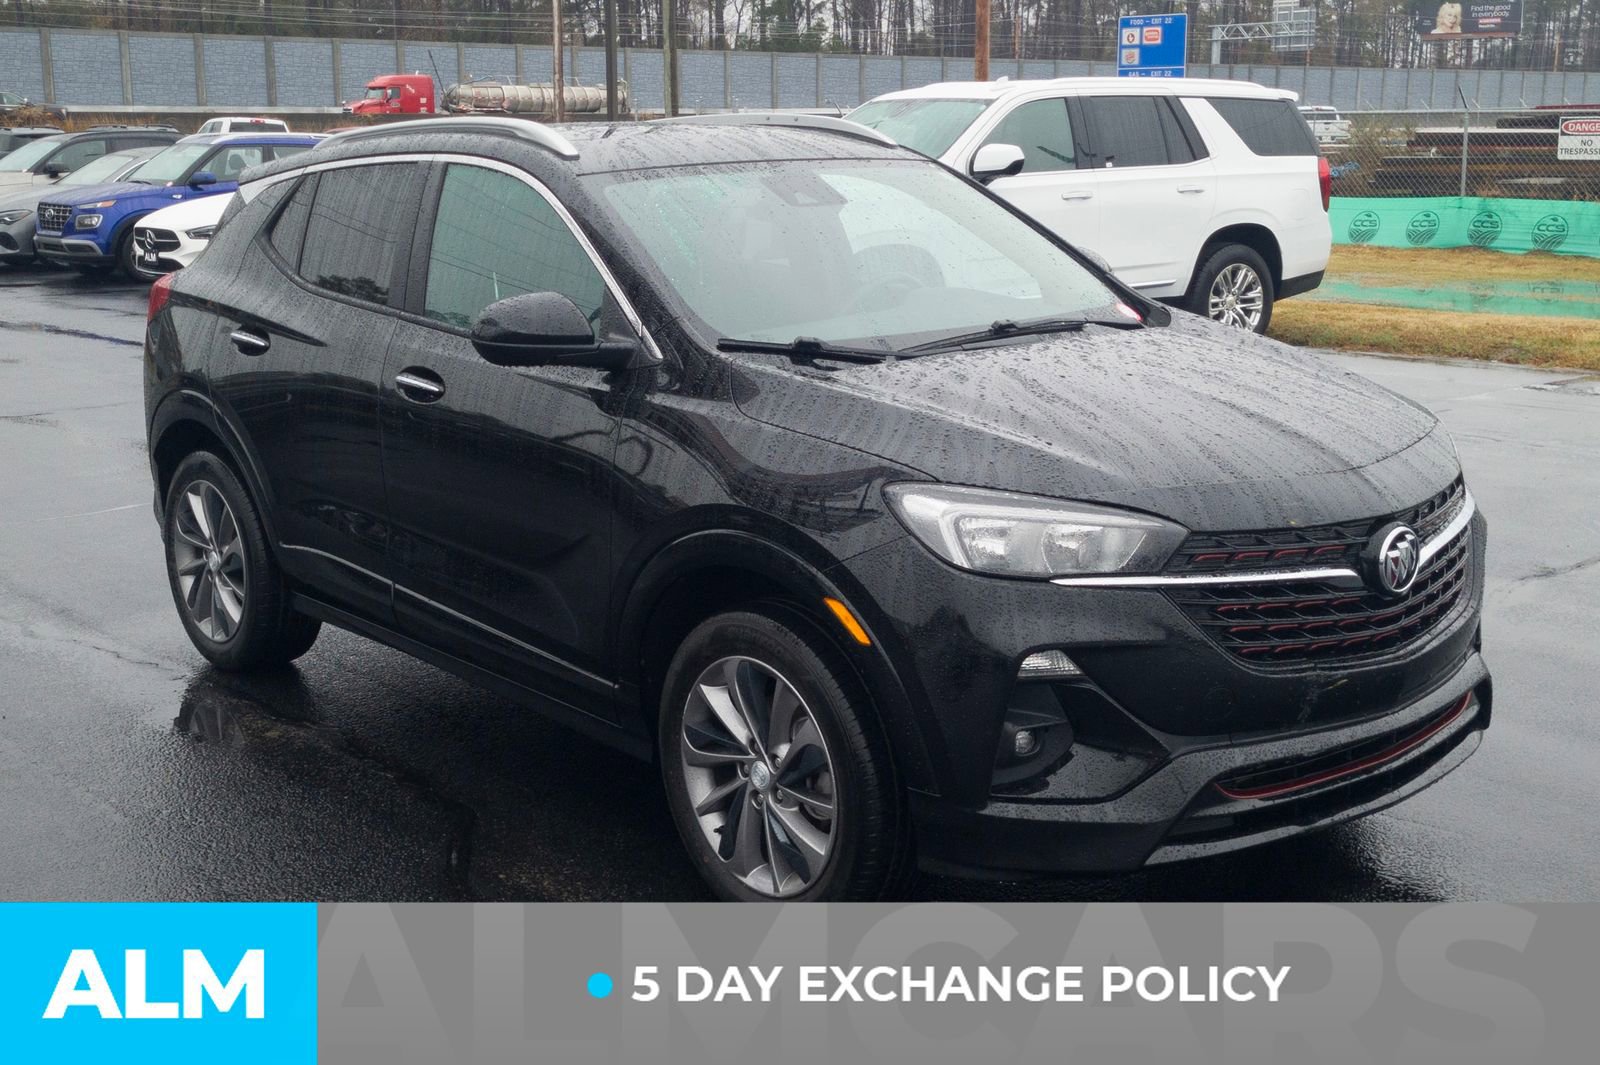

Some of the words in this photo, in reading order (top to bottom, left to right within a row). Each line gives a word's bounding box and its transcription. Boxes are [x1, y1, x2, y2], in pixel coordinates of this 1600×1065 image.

[1580, 139, 1593, 147] NO
[1353, 219, 1377, 227] CCS
[1411, 219, 1436, 228] CCS
[1472, 219, 1500, 229] CCS
[1536, 223, 1566, 232] CCS
[145, 252, 156, 261] ALM
